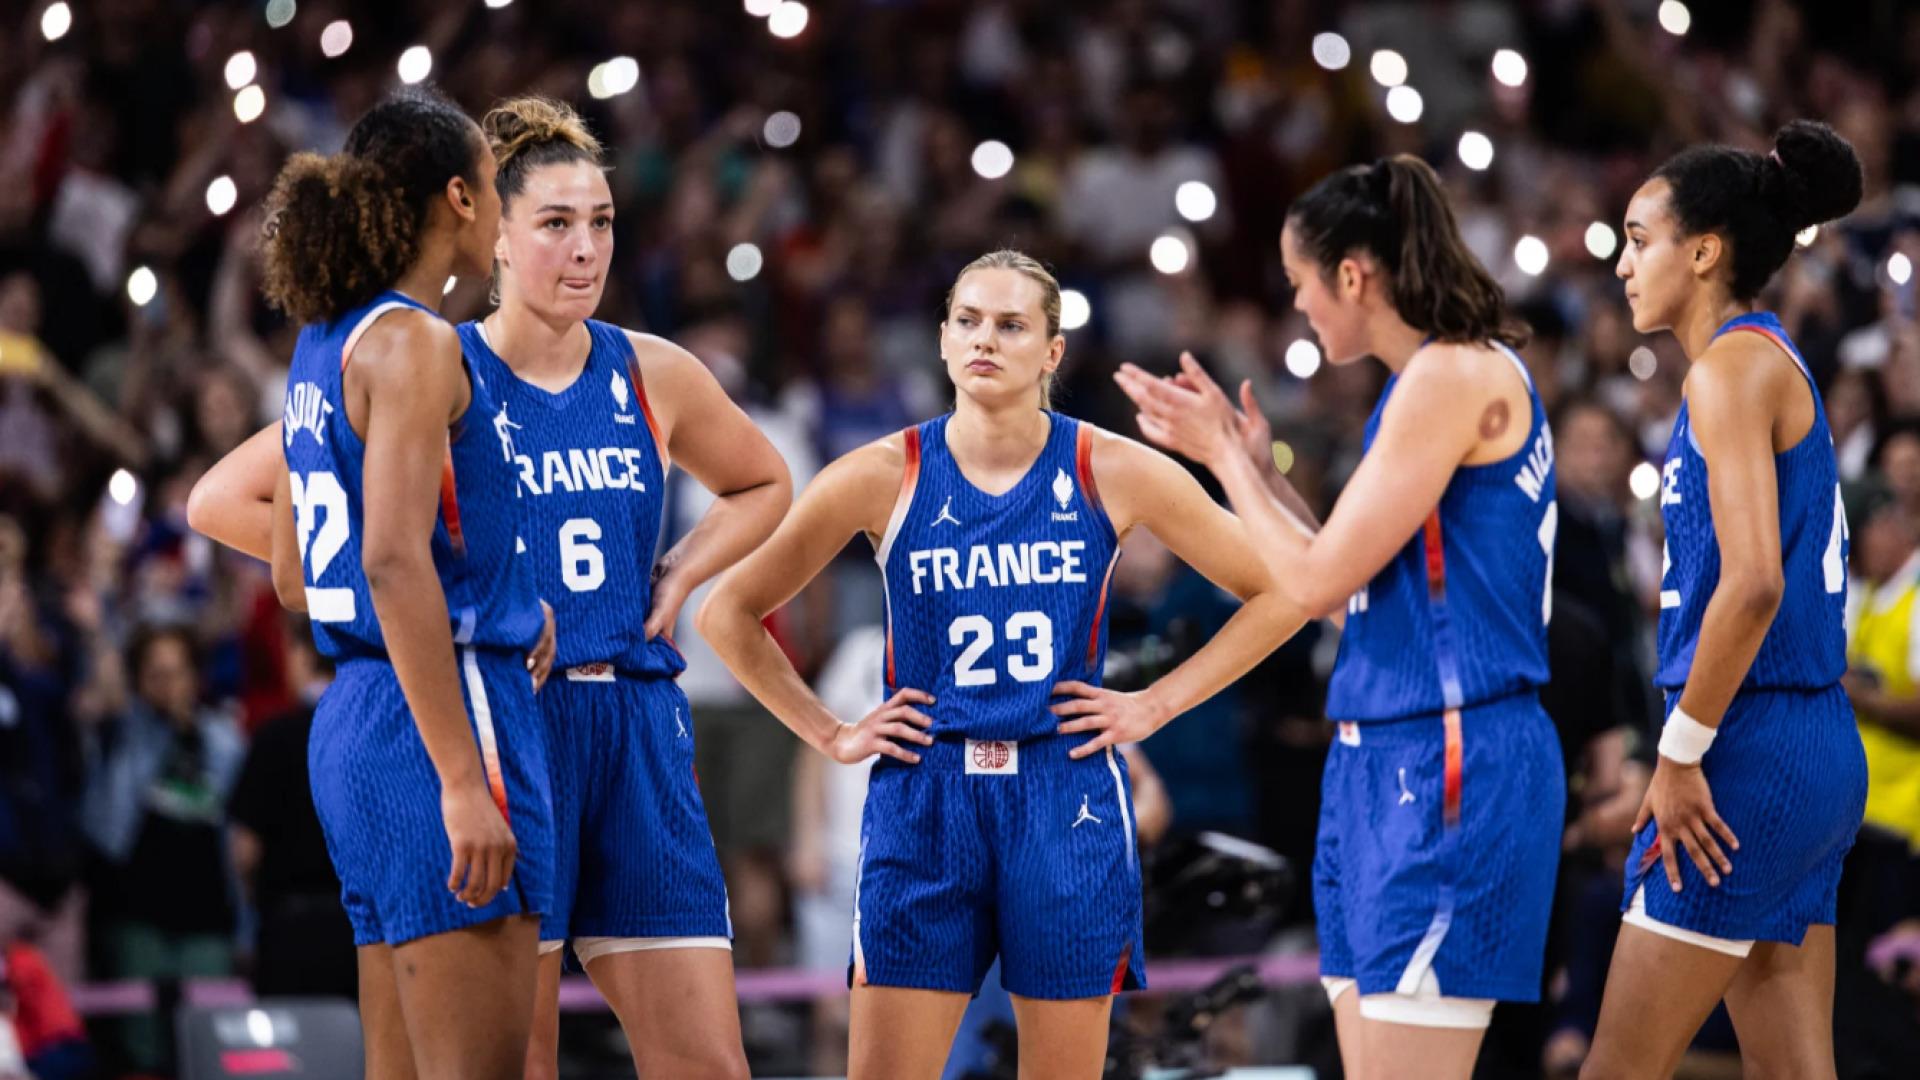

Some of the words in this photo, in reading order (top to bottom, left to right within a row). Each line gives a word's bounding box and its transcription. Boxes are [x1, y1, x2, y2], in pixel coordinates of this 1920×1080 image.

[1051, 510, 1078, 523] FRANCE
[559, 518, 606, 592] 6
[909, 540, 1087, 595] FRANCE
[948, 611, 1054, 687] 23
